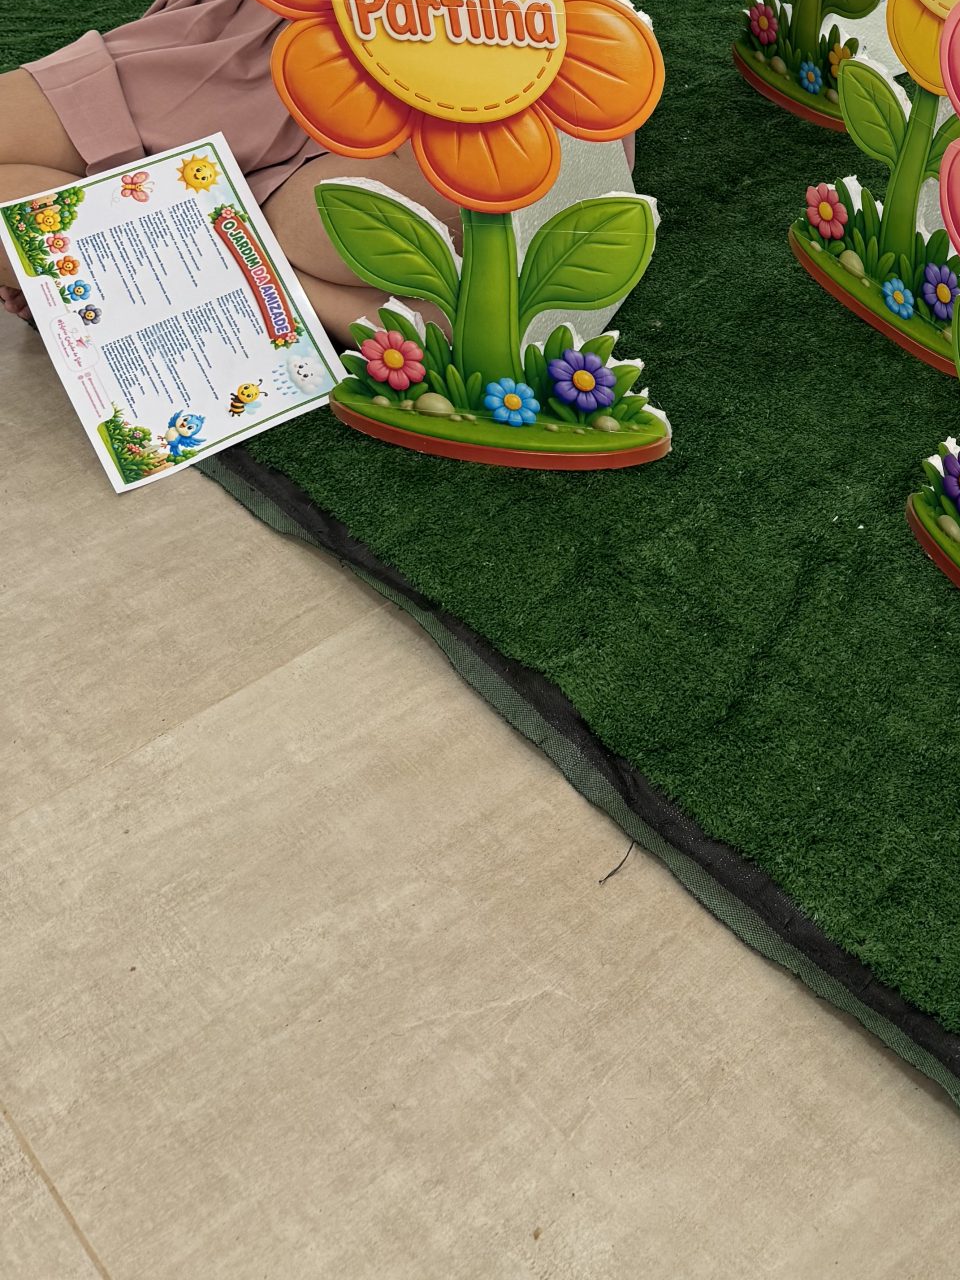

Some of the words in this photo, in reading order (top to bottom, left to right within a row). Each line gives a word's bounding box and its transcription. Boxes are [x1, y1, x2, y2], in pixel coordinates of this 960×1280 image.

[222, 220, 236, 231] O
[228, 230, 261, 269] JARDIM
[252, 266, 270, 286] DA
[260, 284, 290, 335] AMIZADE
